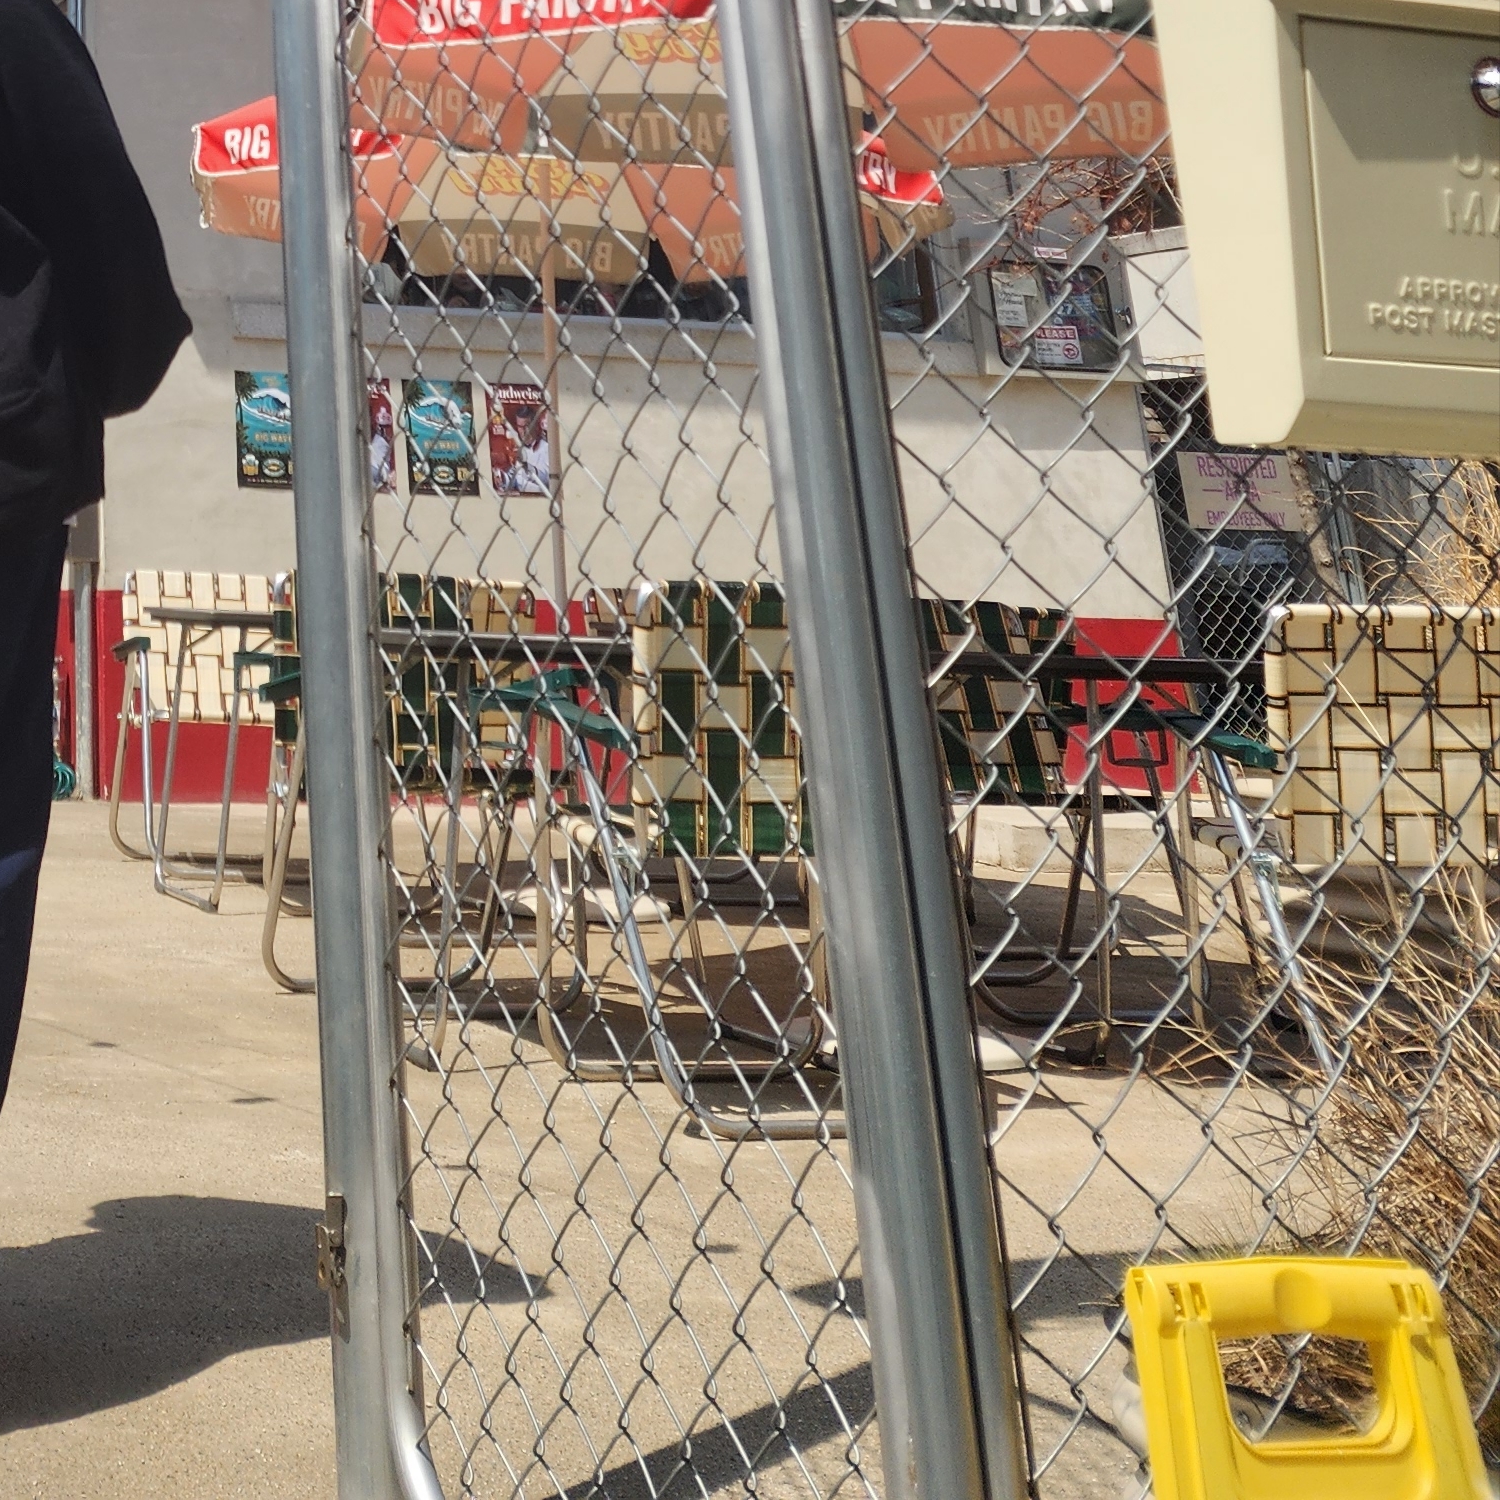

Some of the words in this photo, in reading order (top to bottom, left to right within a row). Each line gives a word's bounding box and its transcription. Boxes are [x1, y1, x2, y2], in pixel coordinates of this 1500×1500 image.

[224, 124, 271, 165] BIG
[1367, 302, 1435, 334] POST
[1197, 456, 1277, 479] RESTRICTED
